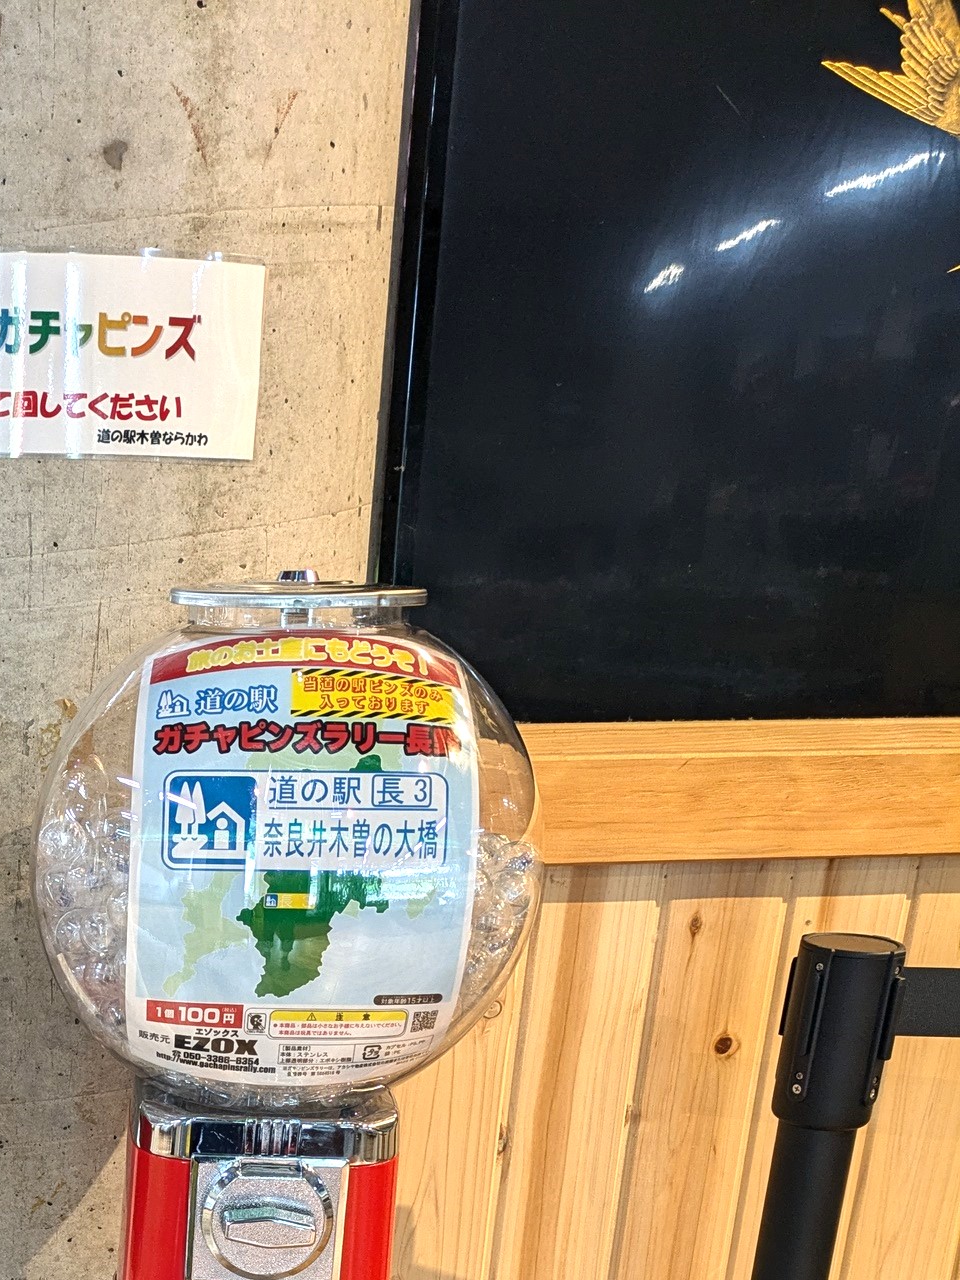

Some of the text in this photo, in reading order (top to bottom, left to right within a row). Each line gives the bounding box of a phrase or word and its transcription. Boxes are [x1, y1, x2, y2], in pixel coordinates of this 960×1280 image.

[97, 428, 209, 446] 道の駅木曽ならかわ
[197, 685, 278, 715] 道の駅
[303, 677, 444, 701] 当道の駅ピンズのみ
[319, 694, 429, 714] 入っております
[268, 775, 361, 804] 道の駅
[263, 818, 438, 859] 奈良井木曽の大橋
[138, 1030, 171, 1044] 販売元
[174, 1034, 258, 1055] EZOX
